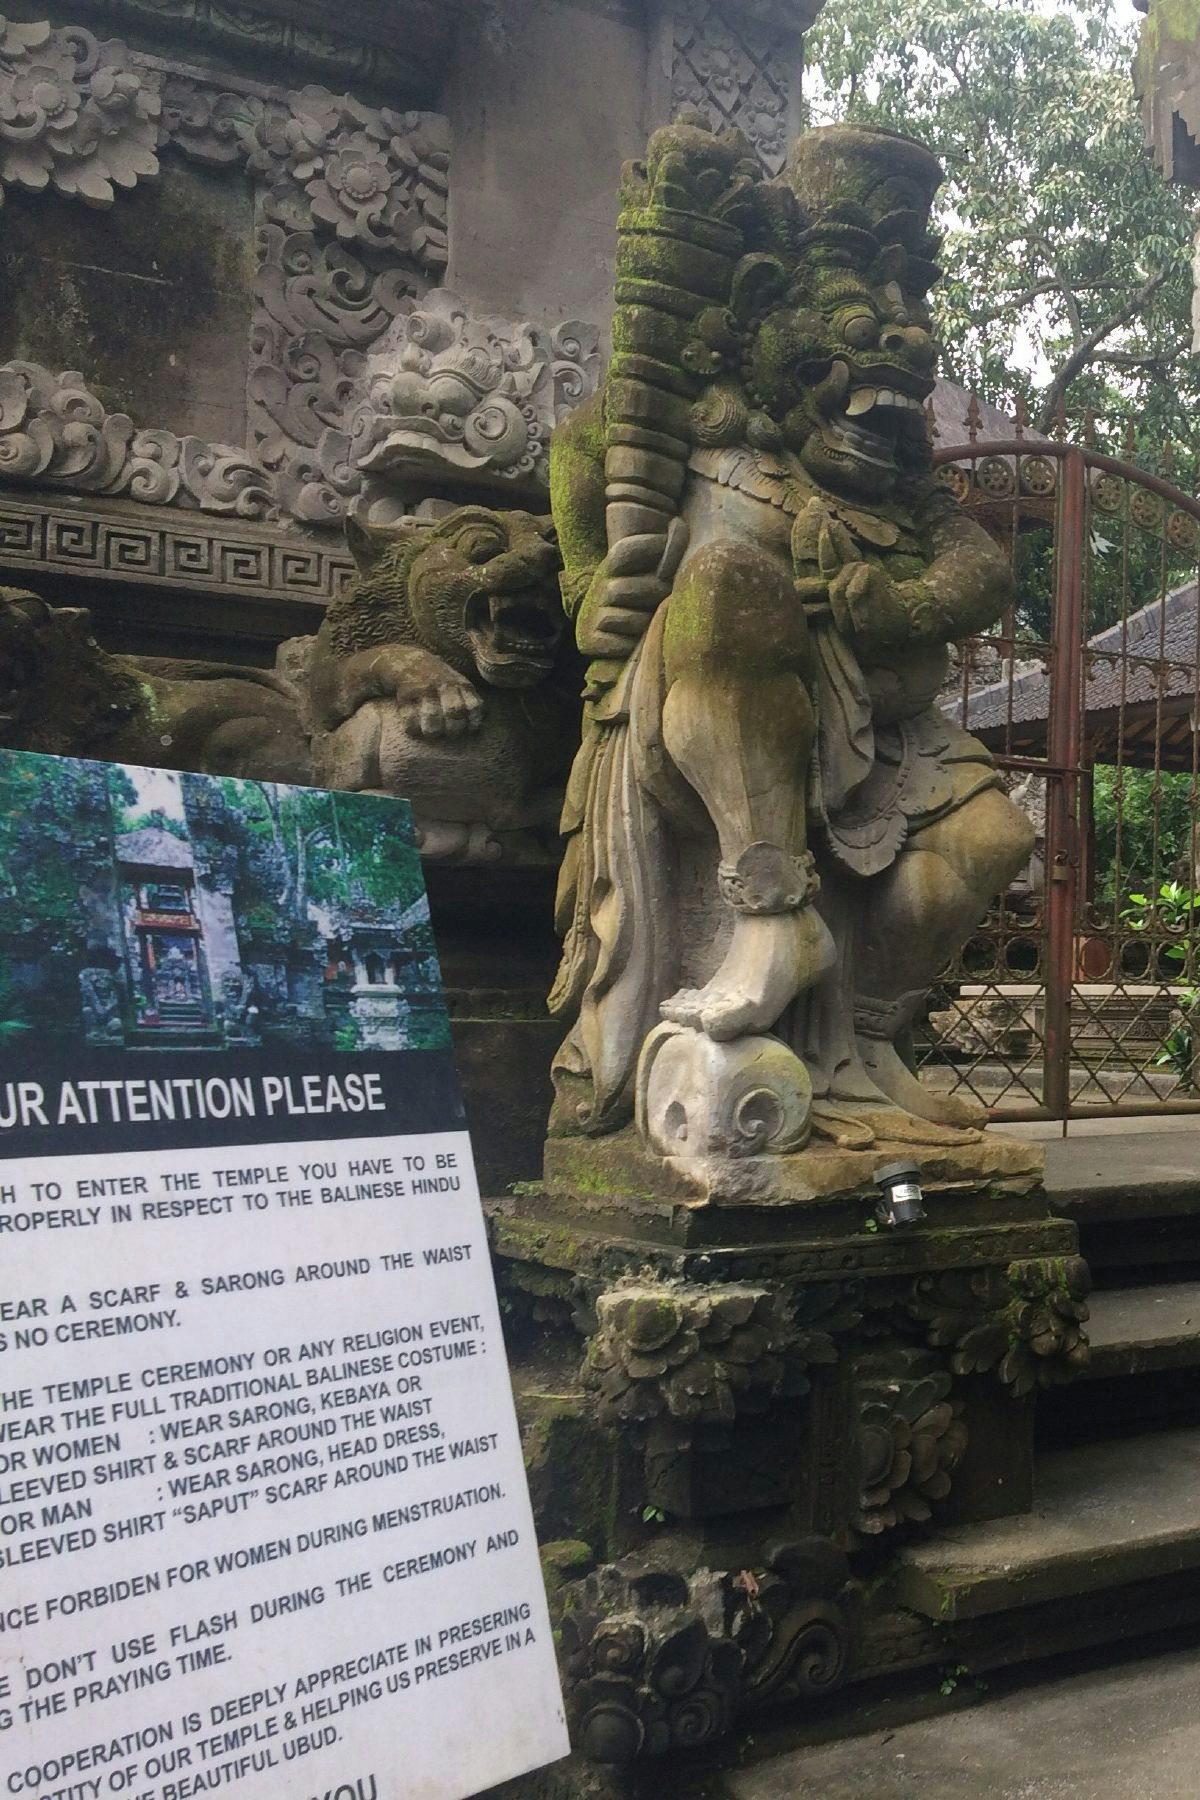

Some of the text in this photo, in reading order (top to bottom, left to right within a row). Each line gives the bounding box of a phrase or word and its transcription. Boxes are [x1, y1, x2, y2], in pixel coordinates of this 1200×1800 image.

[0, 1073, 386, 1128] UR ATTENTION PLEASE
[0, 1152, 458, 1205] H TO ENTER THE TEMPLE YOU HAVE TO BE
[0, 1175, 461, 1234] ROPERLY IN RESPECT TO THE BALINESE HINDU
[0, 1243, 472, 1322] EAR A SCARF & SARONG AROUND THE WAIST
[14, 1327, 50, 1350] NO
[54, 1308, 182, 1344] CEREMONY.
[41, 1372, 133, 1404] TEMPLE
[140, 1351, 256, 1388] CEREMONY
[262, 1346, 293, 1367] OR
[298, 1338, 335, 1362] ANY
[342, 1324, 424, 1354] RELIGION
[428, 1314, 485, 1339] EVENT,
[31, 1432, 121, 1467] WOMEN
[159, 1413, 224, 1442] WEAR
[227, 1396, 316, 1429] SARONG,
[319, 1381, 392, 1411] KEBAYA
[396, 1375, 423, 1395] OR
[60, 1405, 107, 1431] THE
[111, 1396, 167, 1423] FULL
[168, 1372, 303, 1411] TRADITIONAL
[305, 1354, 395, 1387] BALINESE
[397, 1339, 478, 1369] COSTUME
[0, 1511, 37, 1536] OR
[40, 1497, 93, 1528] MAN
[167, 1468, 232, 1499] WEAR
[235, 1448, 324, 1483] SARONG,
[327, 1436, 378, 1463] HEAD
[382, 1421, 445, 1450] DRESS,
[92, 1453, 157, 1486] SHIRT
[163, 1451, 180, 1471] &
[183, 1434, 251, 1466] SCARF
[256, 1418, 337, 1452] AROUND
[339, 1409, 377, 1432] THE
[379, 1397, 433, 1424] WAIST
[102, 1510, 167, 1544] SHIRT
[264, 1473, 328, 1505] SCARF
[333, 1455, 409, 1489] AROUND
[411, 1445, 447, 1469] THE
[448, 1432, 499, 1460] WAIST
[45, 1571, 161, 1621] FORBIDEN
[165, 1559, 212, 1589] FOR
[213, 1537, 292, 1575] WOMEN
[296, 1518, 369, 1553] DURING
[371, 1482, 506, 1533] MENSTRUATION.
[111, 1633, 158, 1664] USE
[169, 1609, 238, 1648] FLASH
[249, 1585, 326, 1624] DURING
[334, 1571, 373, 1598] THE
[382, 1539, 477, 1584] CEREMONY
[486, 1529, 519, 1554] AND
[6, 1602, 531, 1794] COOPERATION IS DEEPLY APPRECIATE IN PRESERING
[18, 1691, 68, 1724] THE
[73, 1660, 172, 1708] PRAYING
[175, 1642, 233, 1675] TIME.
[39, 1627, 537, 1800] TITY OF OUR TEMPLE & HELPING US PRESERVE IN A
[162, 1725, 343, 1800] BEAUTIFUL UBUD.
